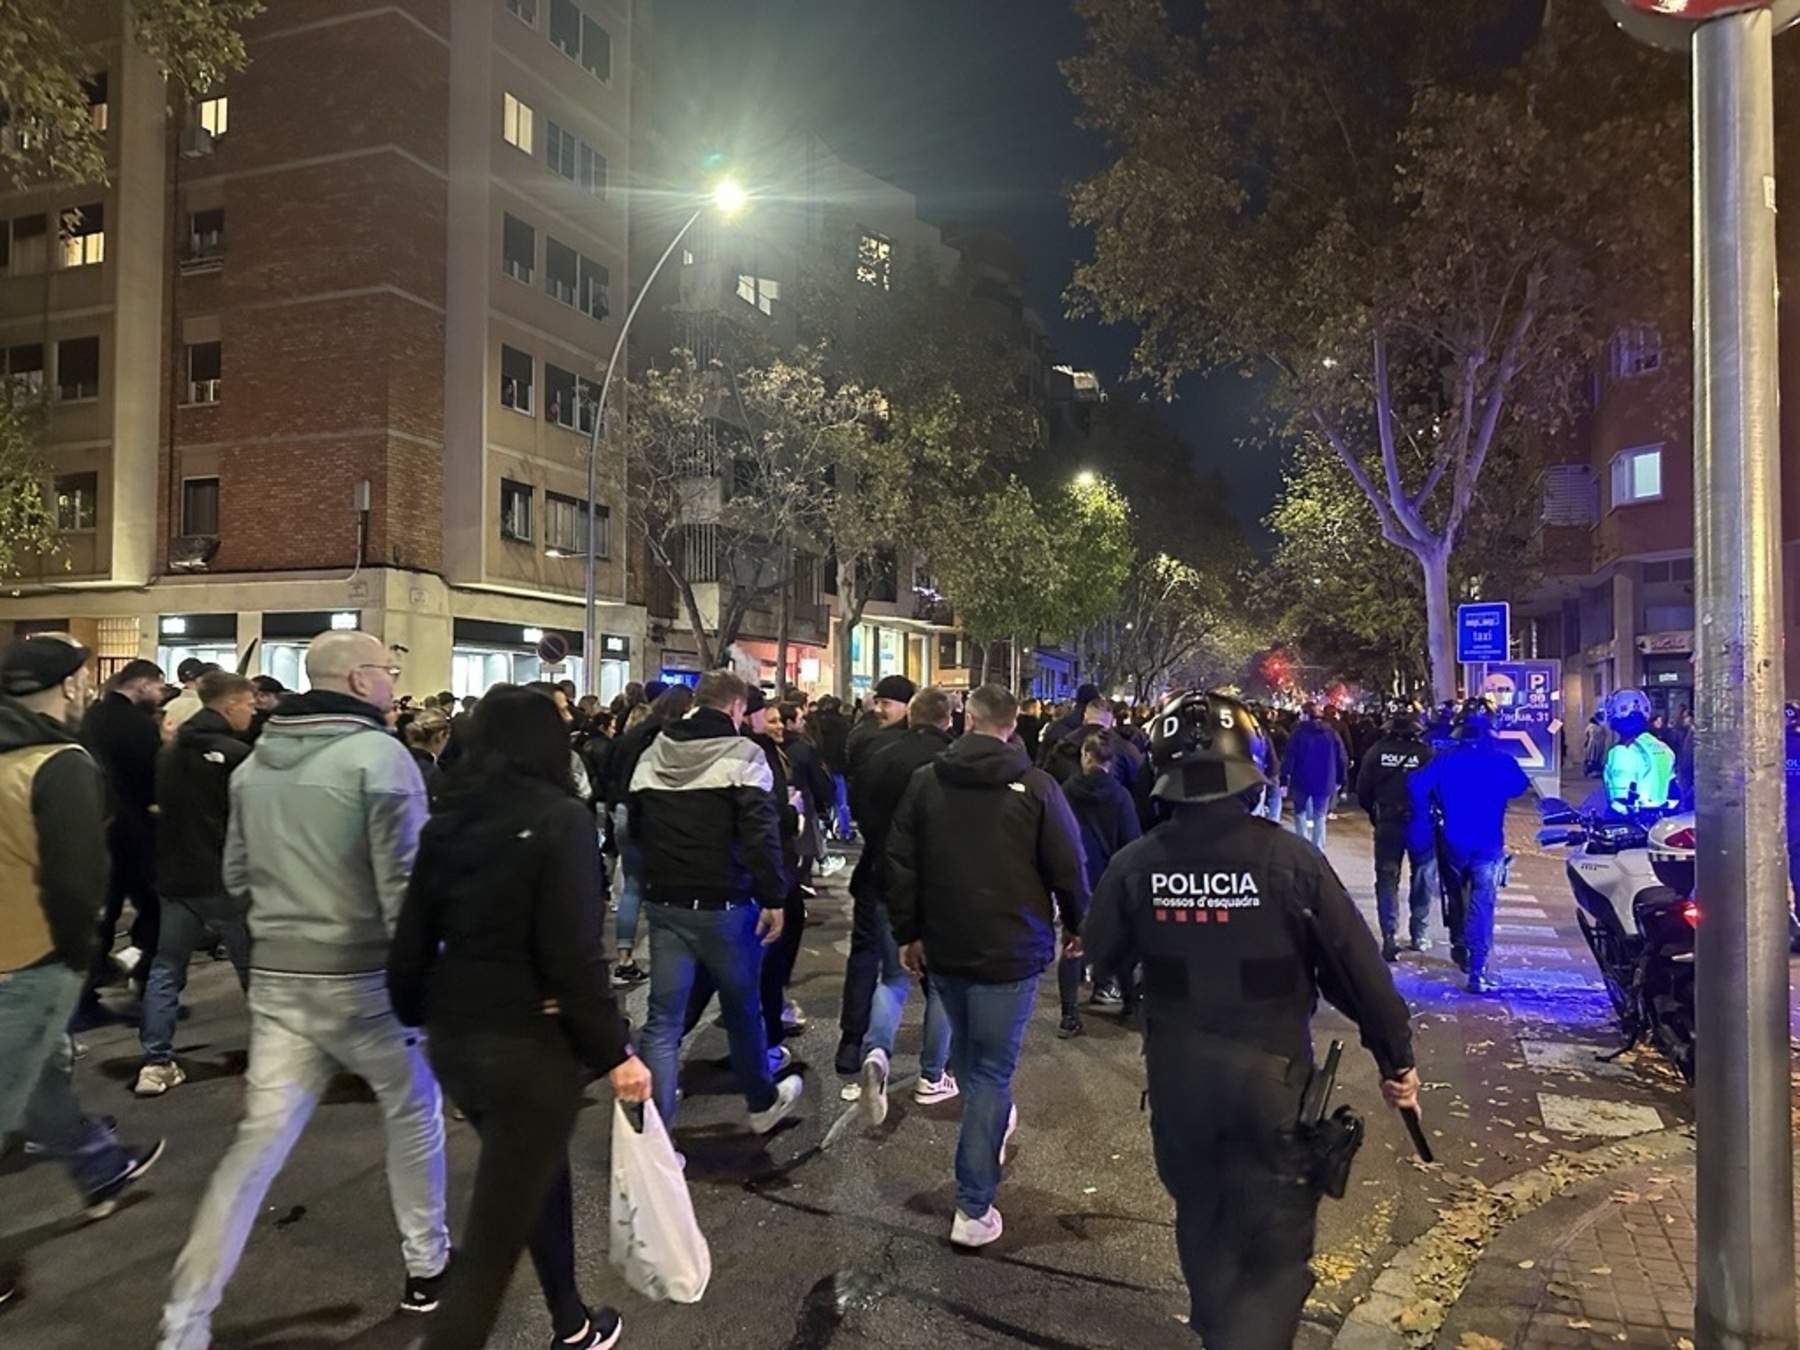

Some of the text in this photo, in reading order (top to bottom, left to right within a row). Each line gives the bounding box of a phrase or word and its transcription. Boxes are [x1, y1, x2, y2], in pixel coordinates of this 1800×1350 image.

[1473, 629, 1492, 641] taxi
[1530, 674, 1546, 690] P
[1163, 708, 1235, 738] D 5
[1536, 711, 1549, 722] 31
[1151, 873, 1259, 895] POLICIA
[1153, 895, 1261, 910] mossos d'esquadra
